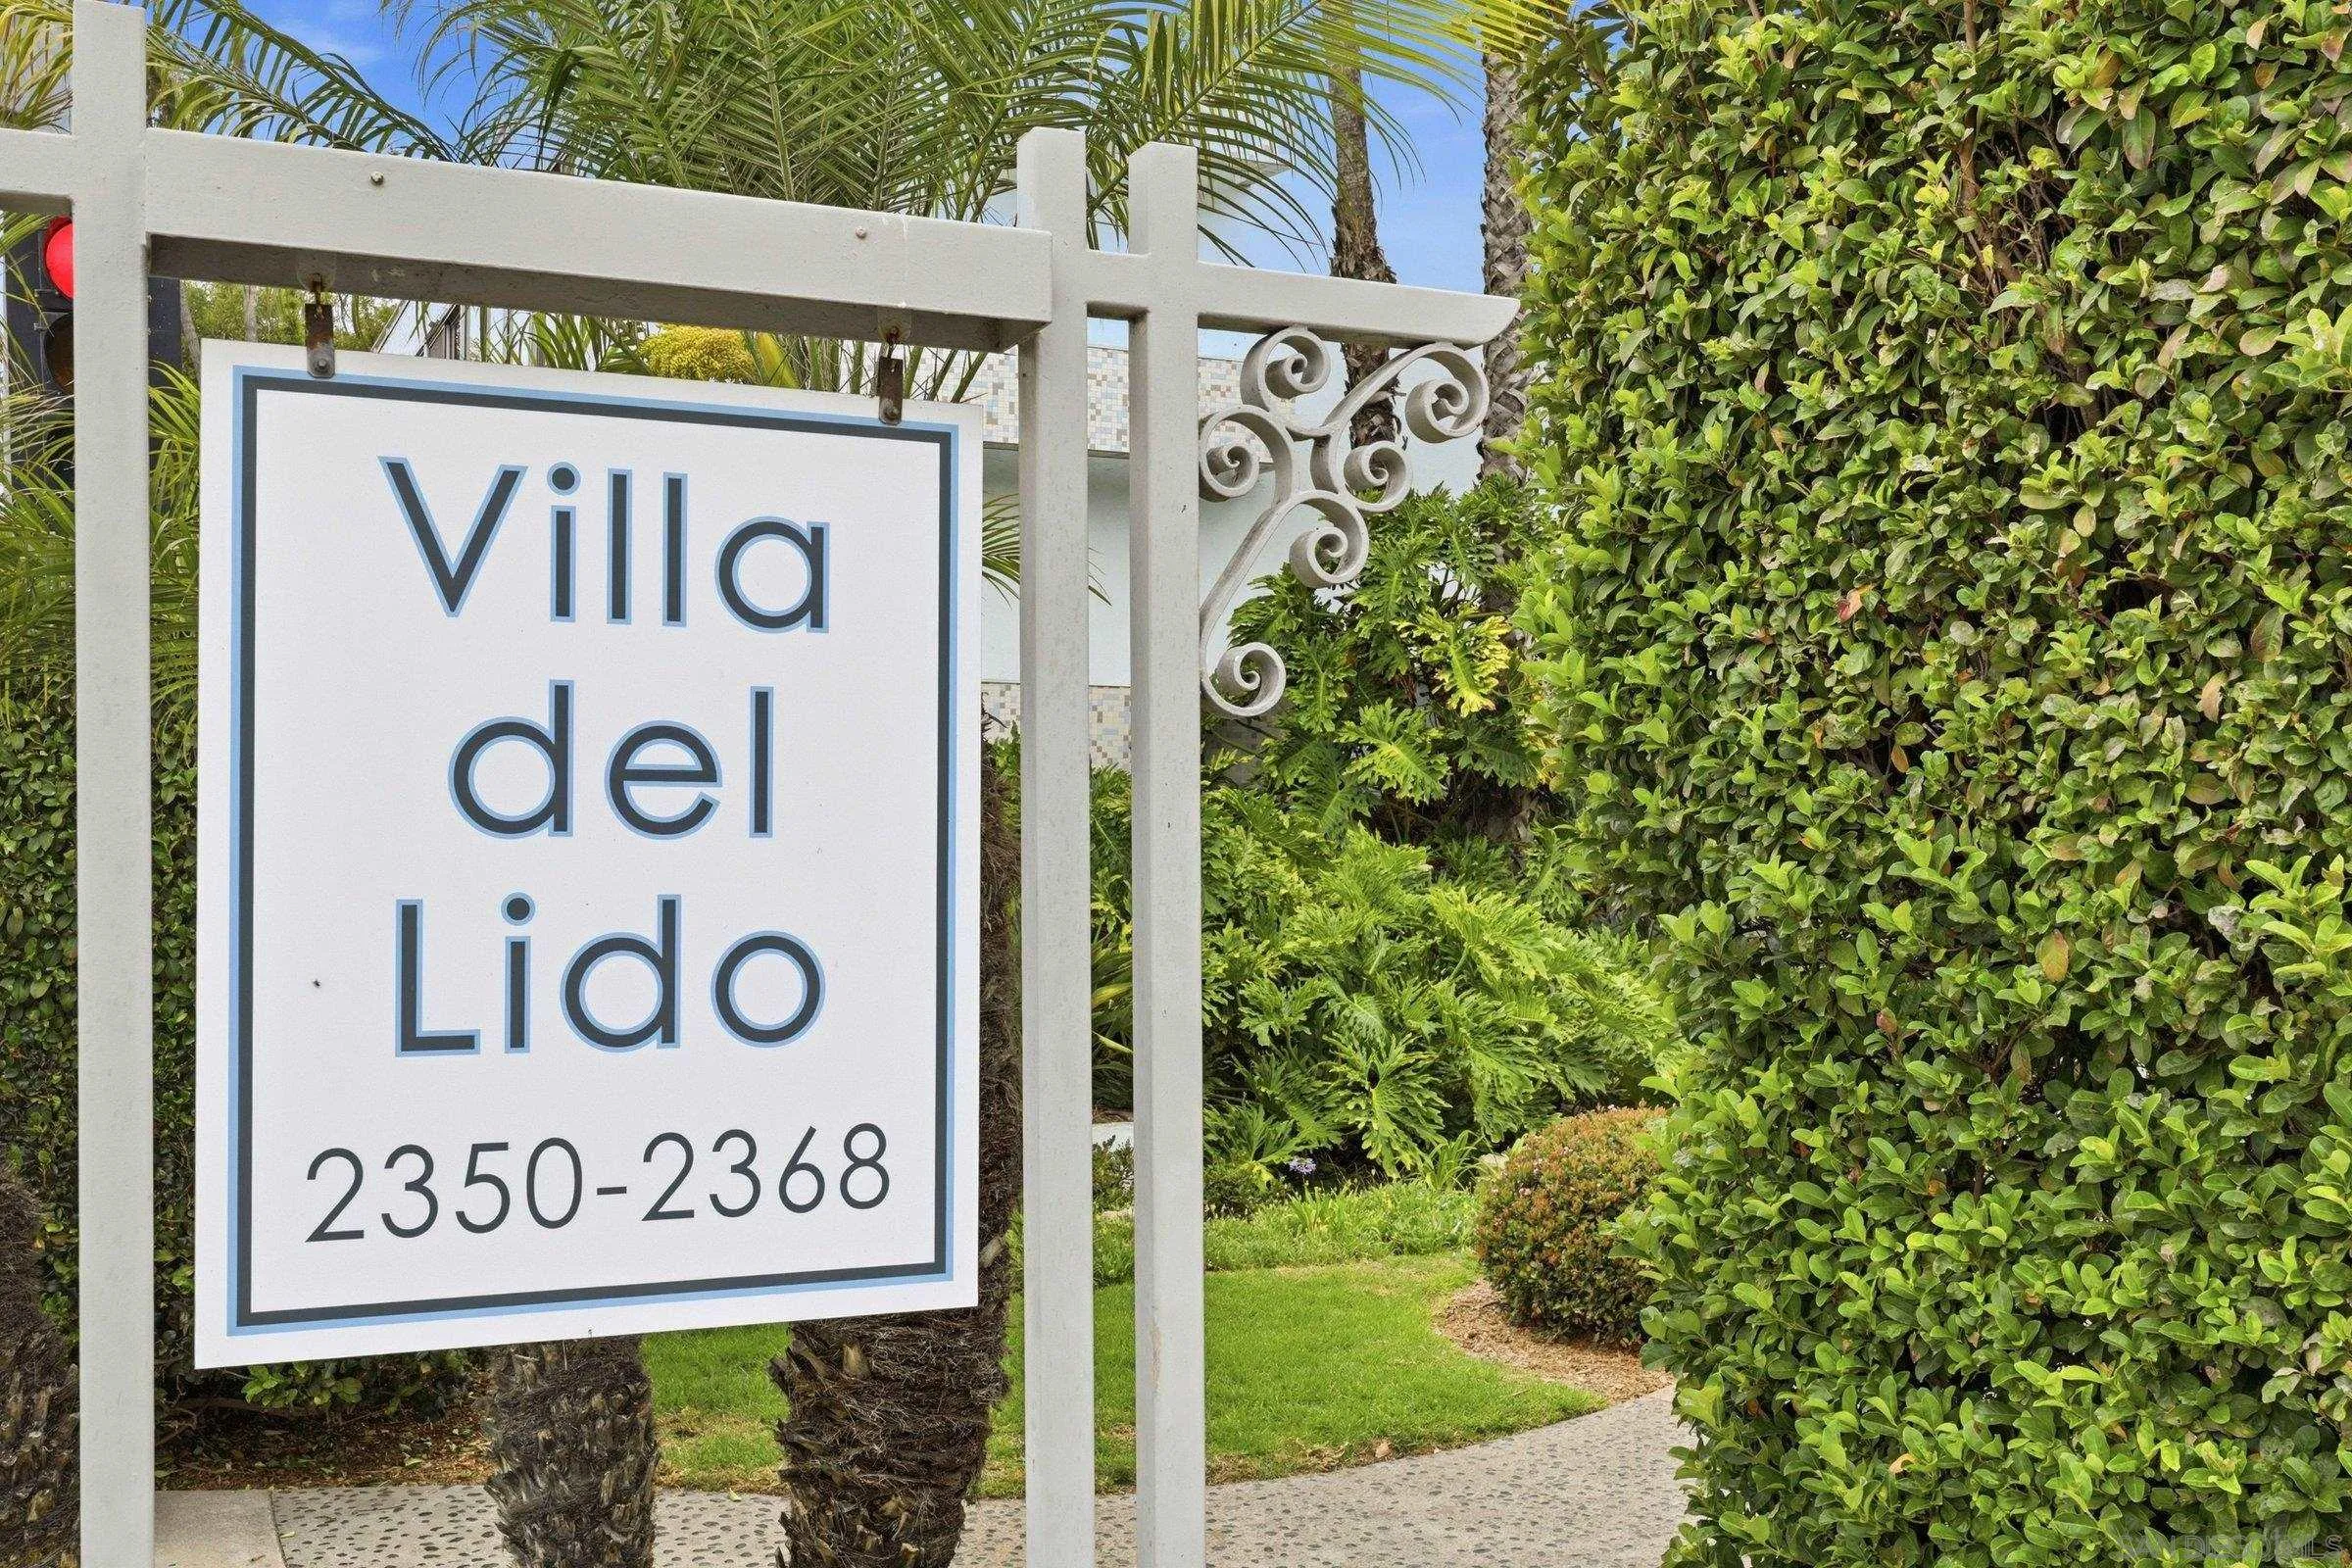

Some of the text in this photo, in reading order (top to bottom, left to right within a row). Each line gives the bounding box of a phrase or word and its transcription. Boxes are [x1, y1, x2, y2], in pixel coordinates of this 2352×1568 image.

[378, 456, 828, 631] Villa
[449, 679, 773, 839] del
[394, 893, 824, 1054] Lido
[305, 1123, 890, 1243] 2350-2368
